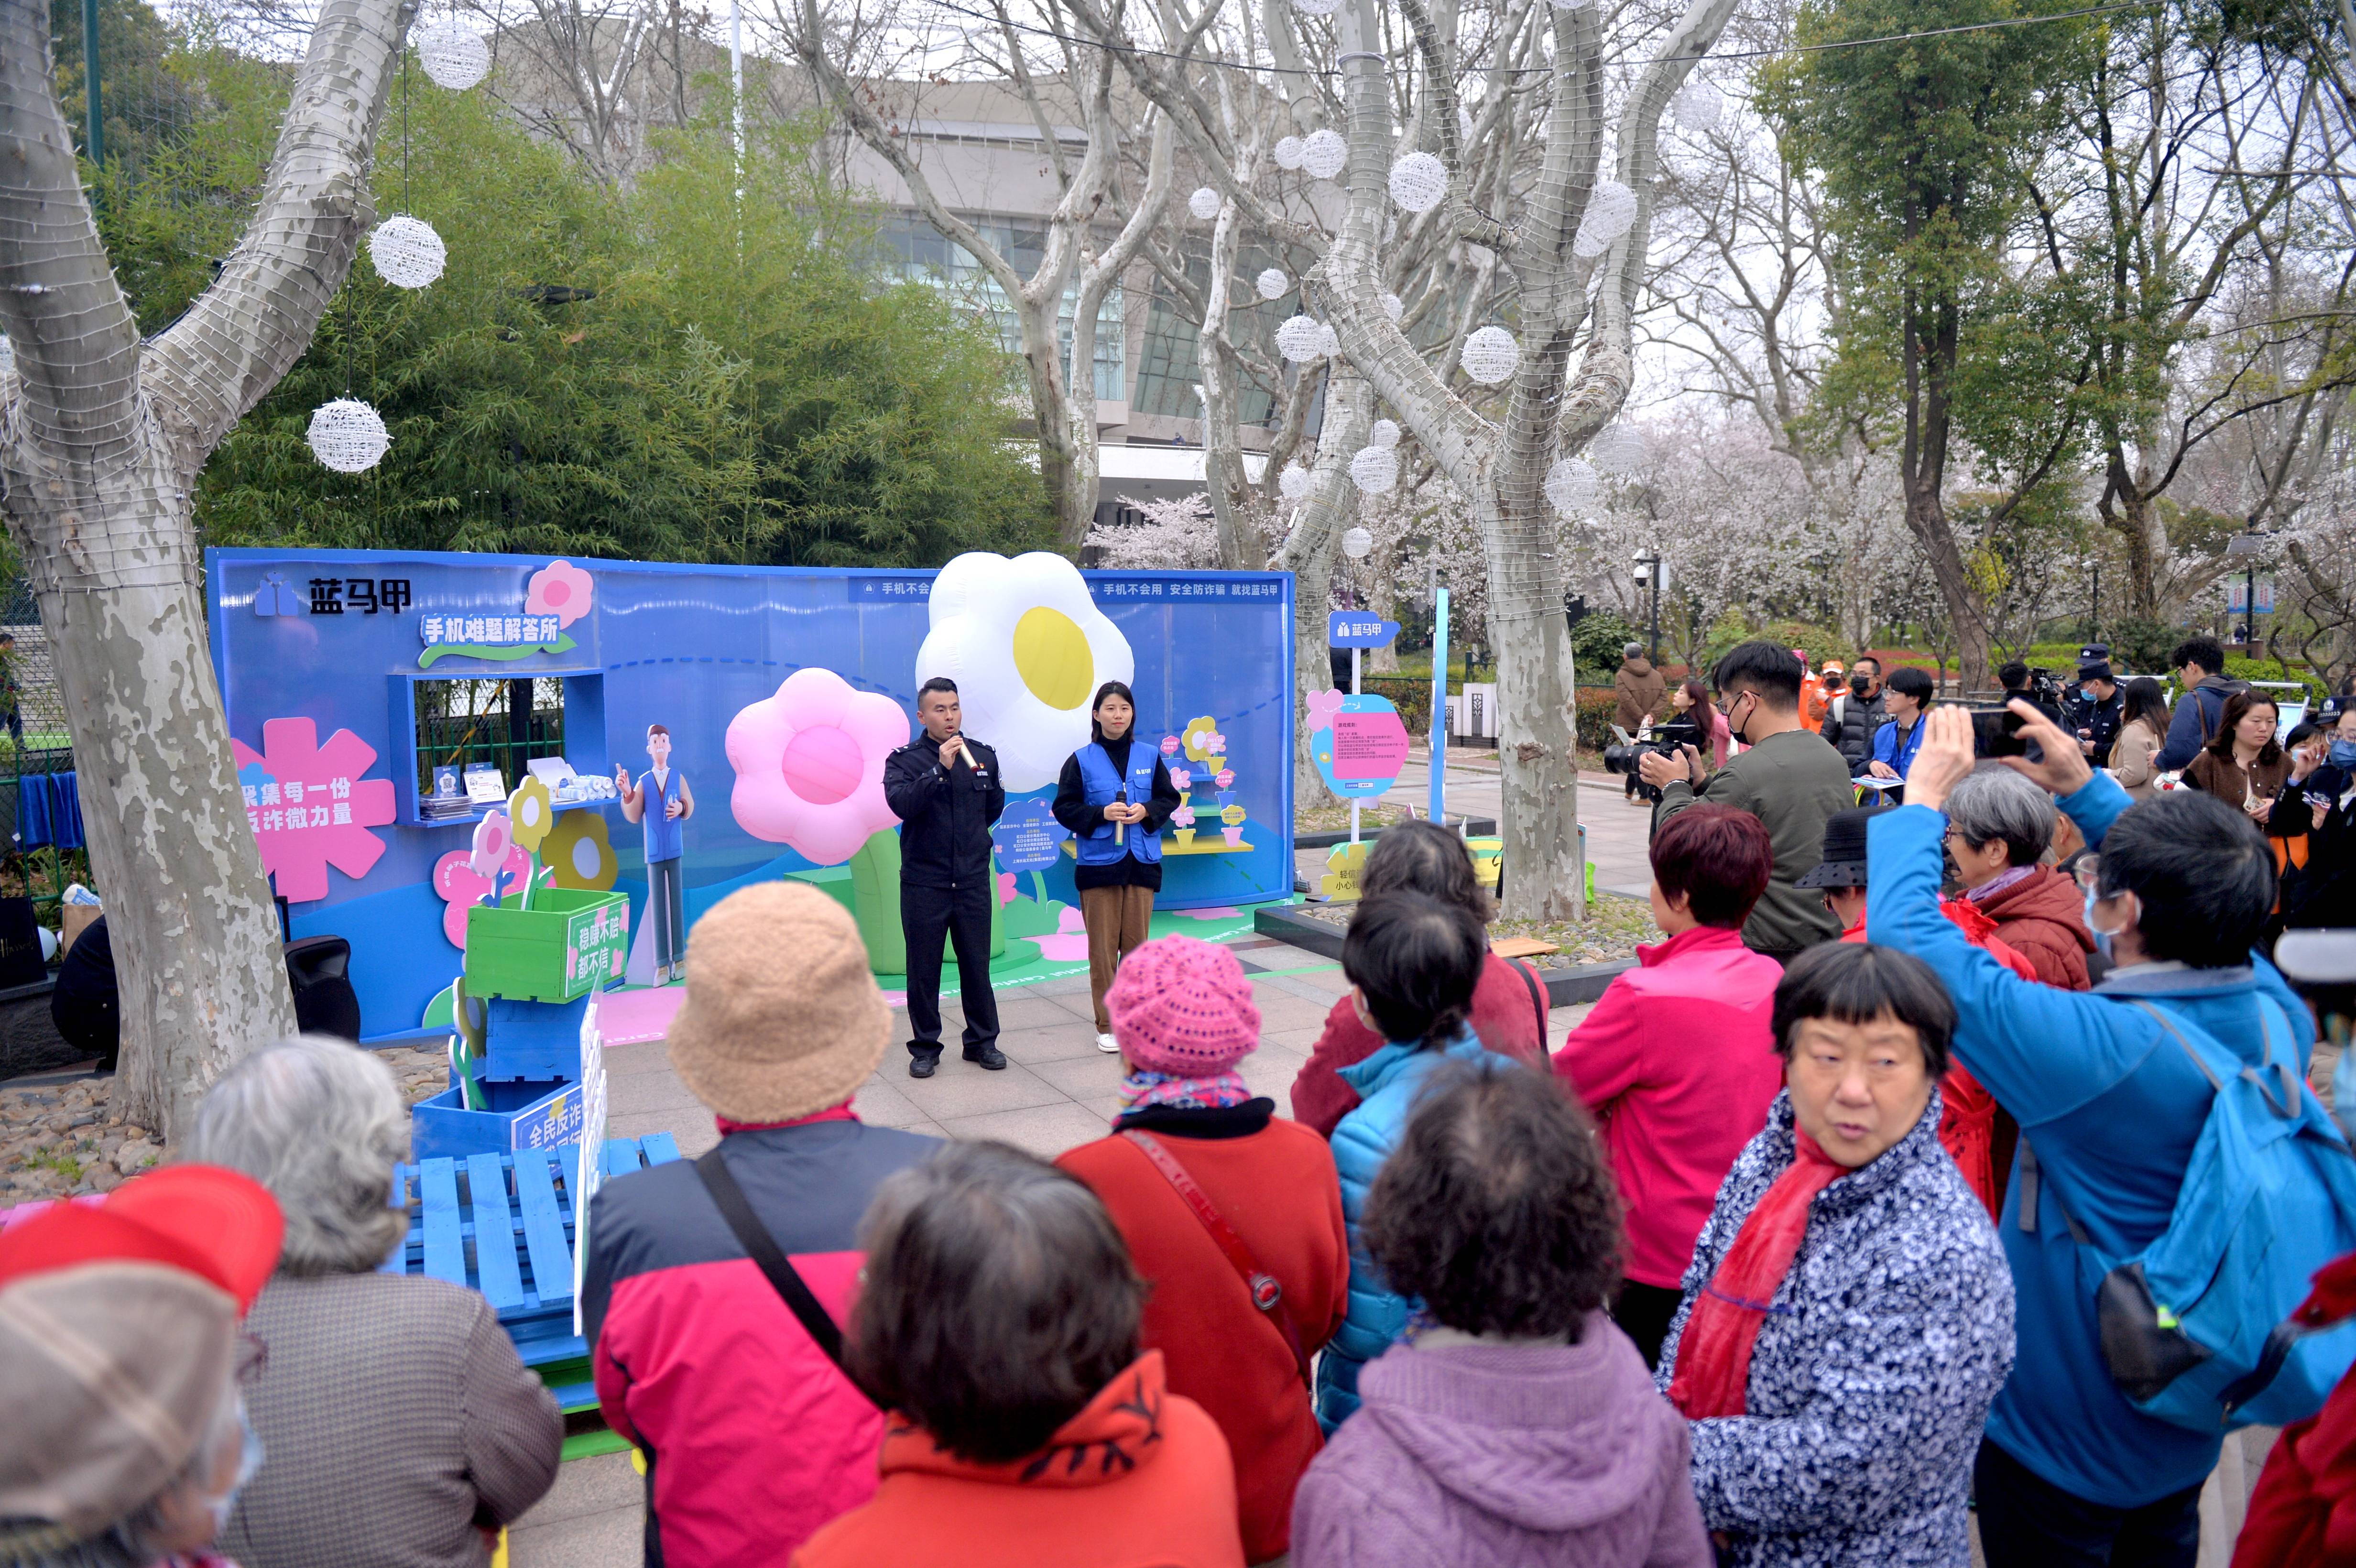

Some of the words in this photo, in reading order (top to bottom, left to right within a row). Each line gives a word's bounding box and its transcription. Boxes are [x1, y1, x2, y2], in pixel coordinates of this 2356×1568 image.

[309, 578, 411, 614] 蓝马甲
[882, 582, 933, 595] 手机不会
[1103, 584, 1162, 595] 手机不会用
[1170, 584, 1225, 596] 安全防诈骗
[1231, 584, 1277, 596] 就找蓝马甲
[425, 617, 558, 642] 手机难题解答所
[1352, 623, 1381, 636] 蓝马甲
[247, 802, 352, 833] 反诈微力量
[1340, 869, 1361, 879] 轻信
[579, 915, 619, 952] 稳赚不赔
[578, 946, 609, 980] 都不信
[1049, 966, 1090, 977] areful
[529, 1103, 582, 1149] 全民反诈
